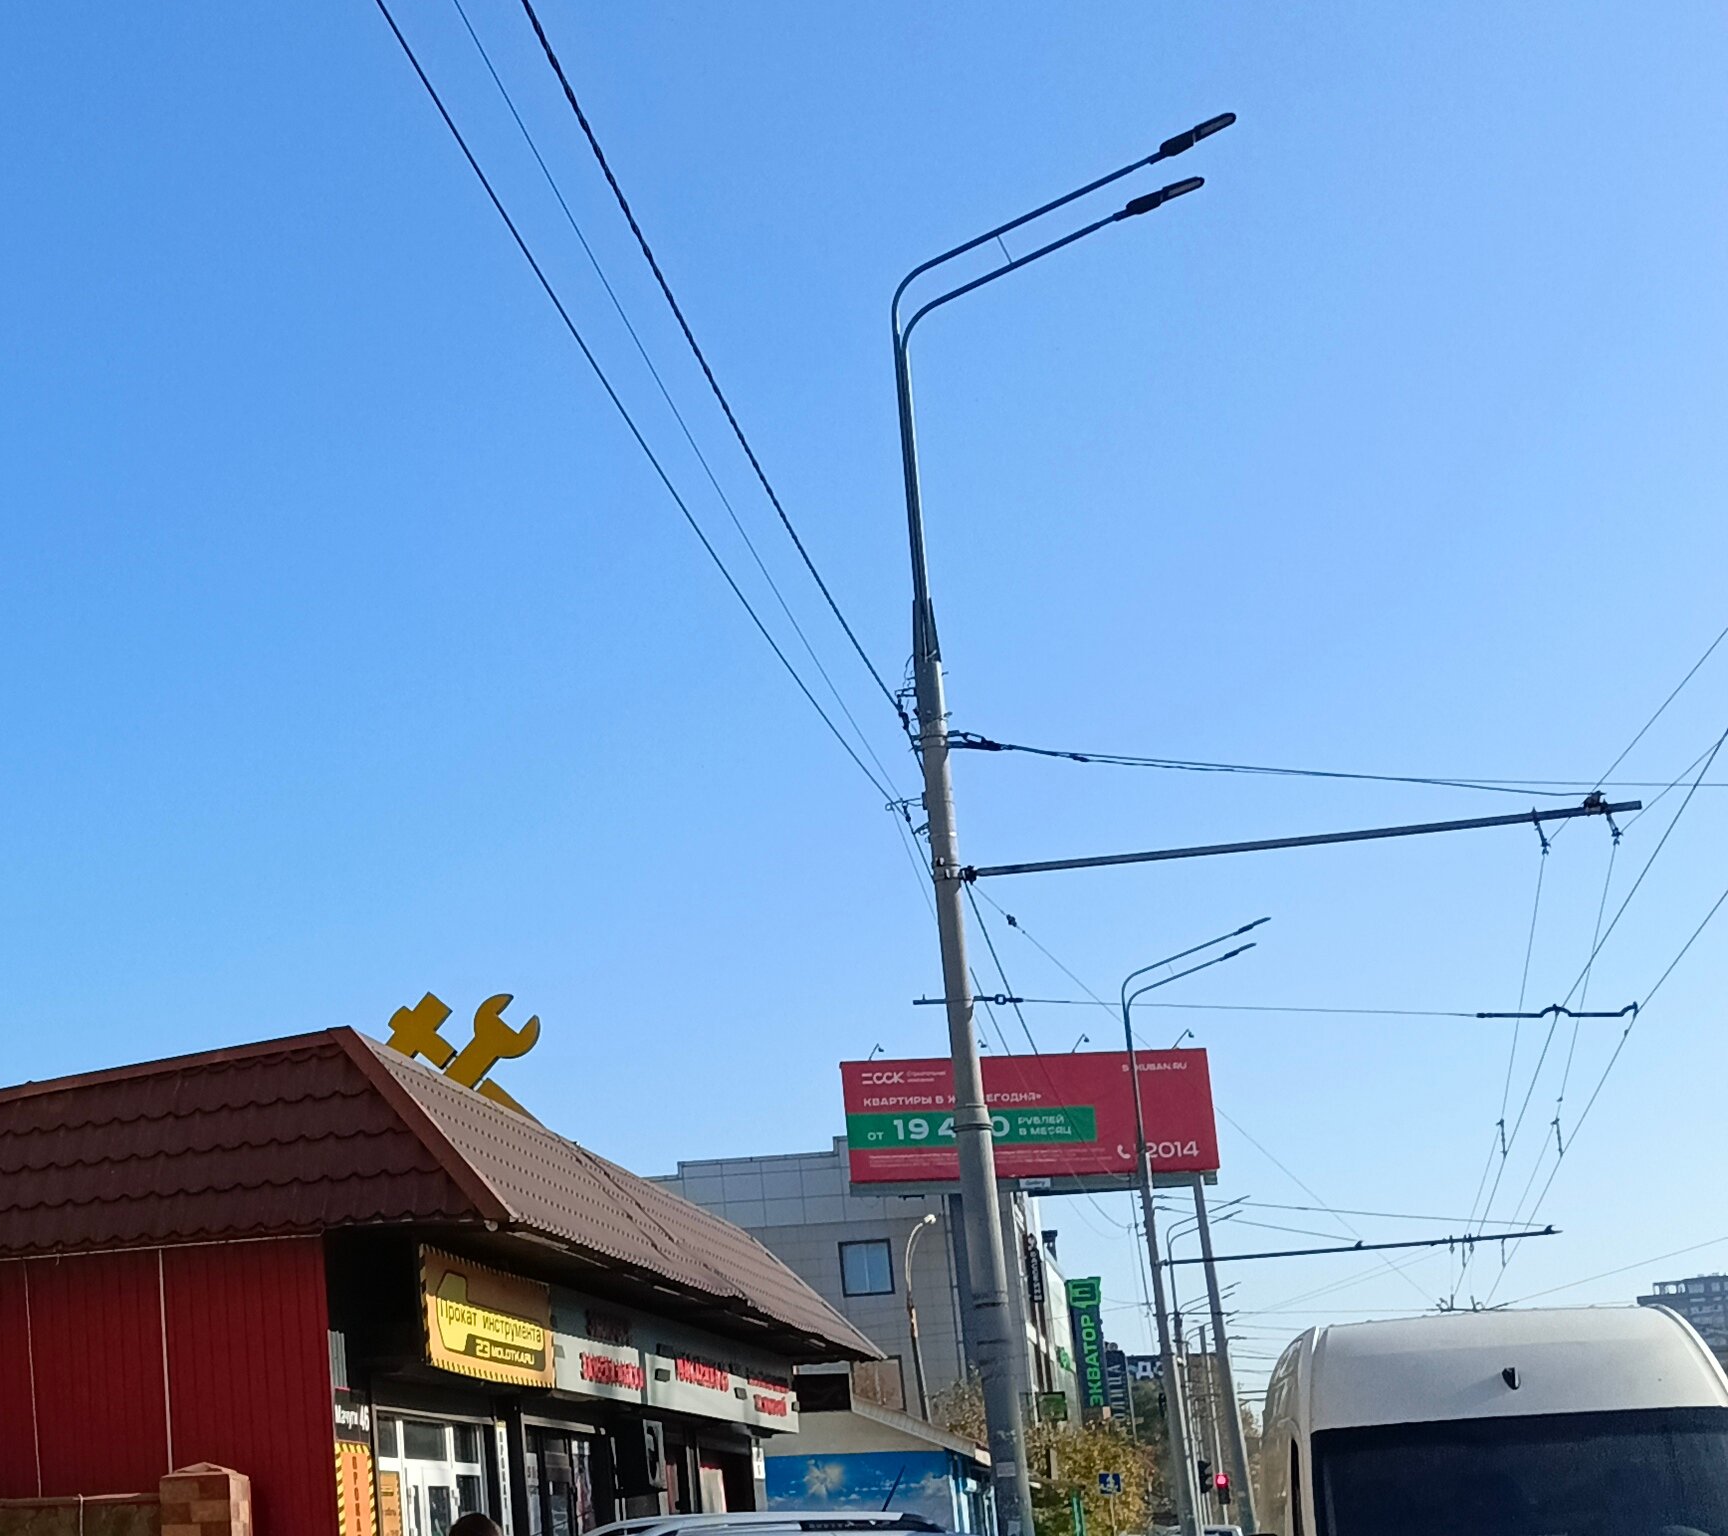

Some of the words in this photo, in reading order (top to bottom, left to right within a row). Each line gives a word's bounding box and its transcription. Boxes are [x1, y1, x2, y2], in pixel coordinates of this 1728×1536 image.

[863, 1095, 932, 1107] КВАРТИРЫ
[935, 1095, 944, 1105] В
[985, 1091, 1042, 1103] ЕГОДНЯ»
[893, 1118, 929, 1141] 19
[1017, 1114, 1065, 1125] РУБЛЕЙ
[439, 1299, 478, 1327] Прокат
[1080, 1314, 1104, 1407] ЭКВАТОР
